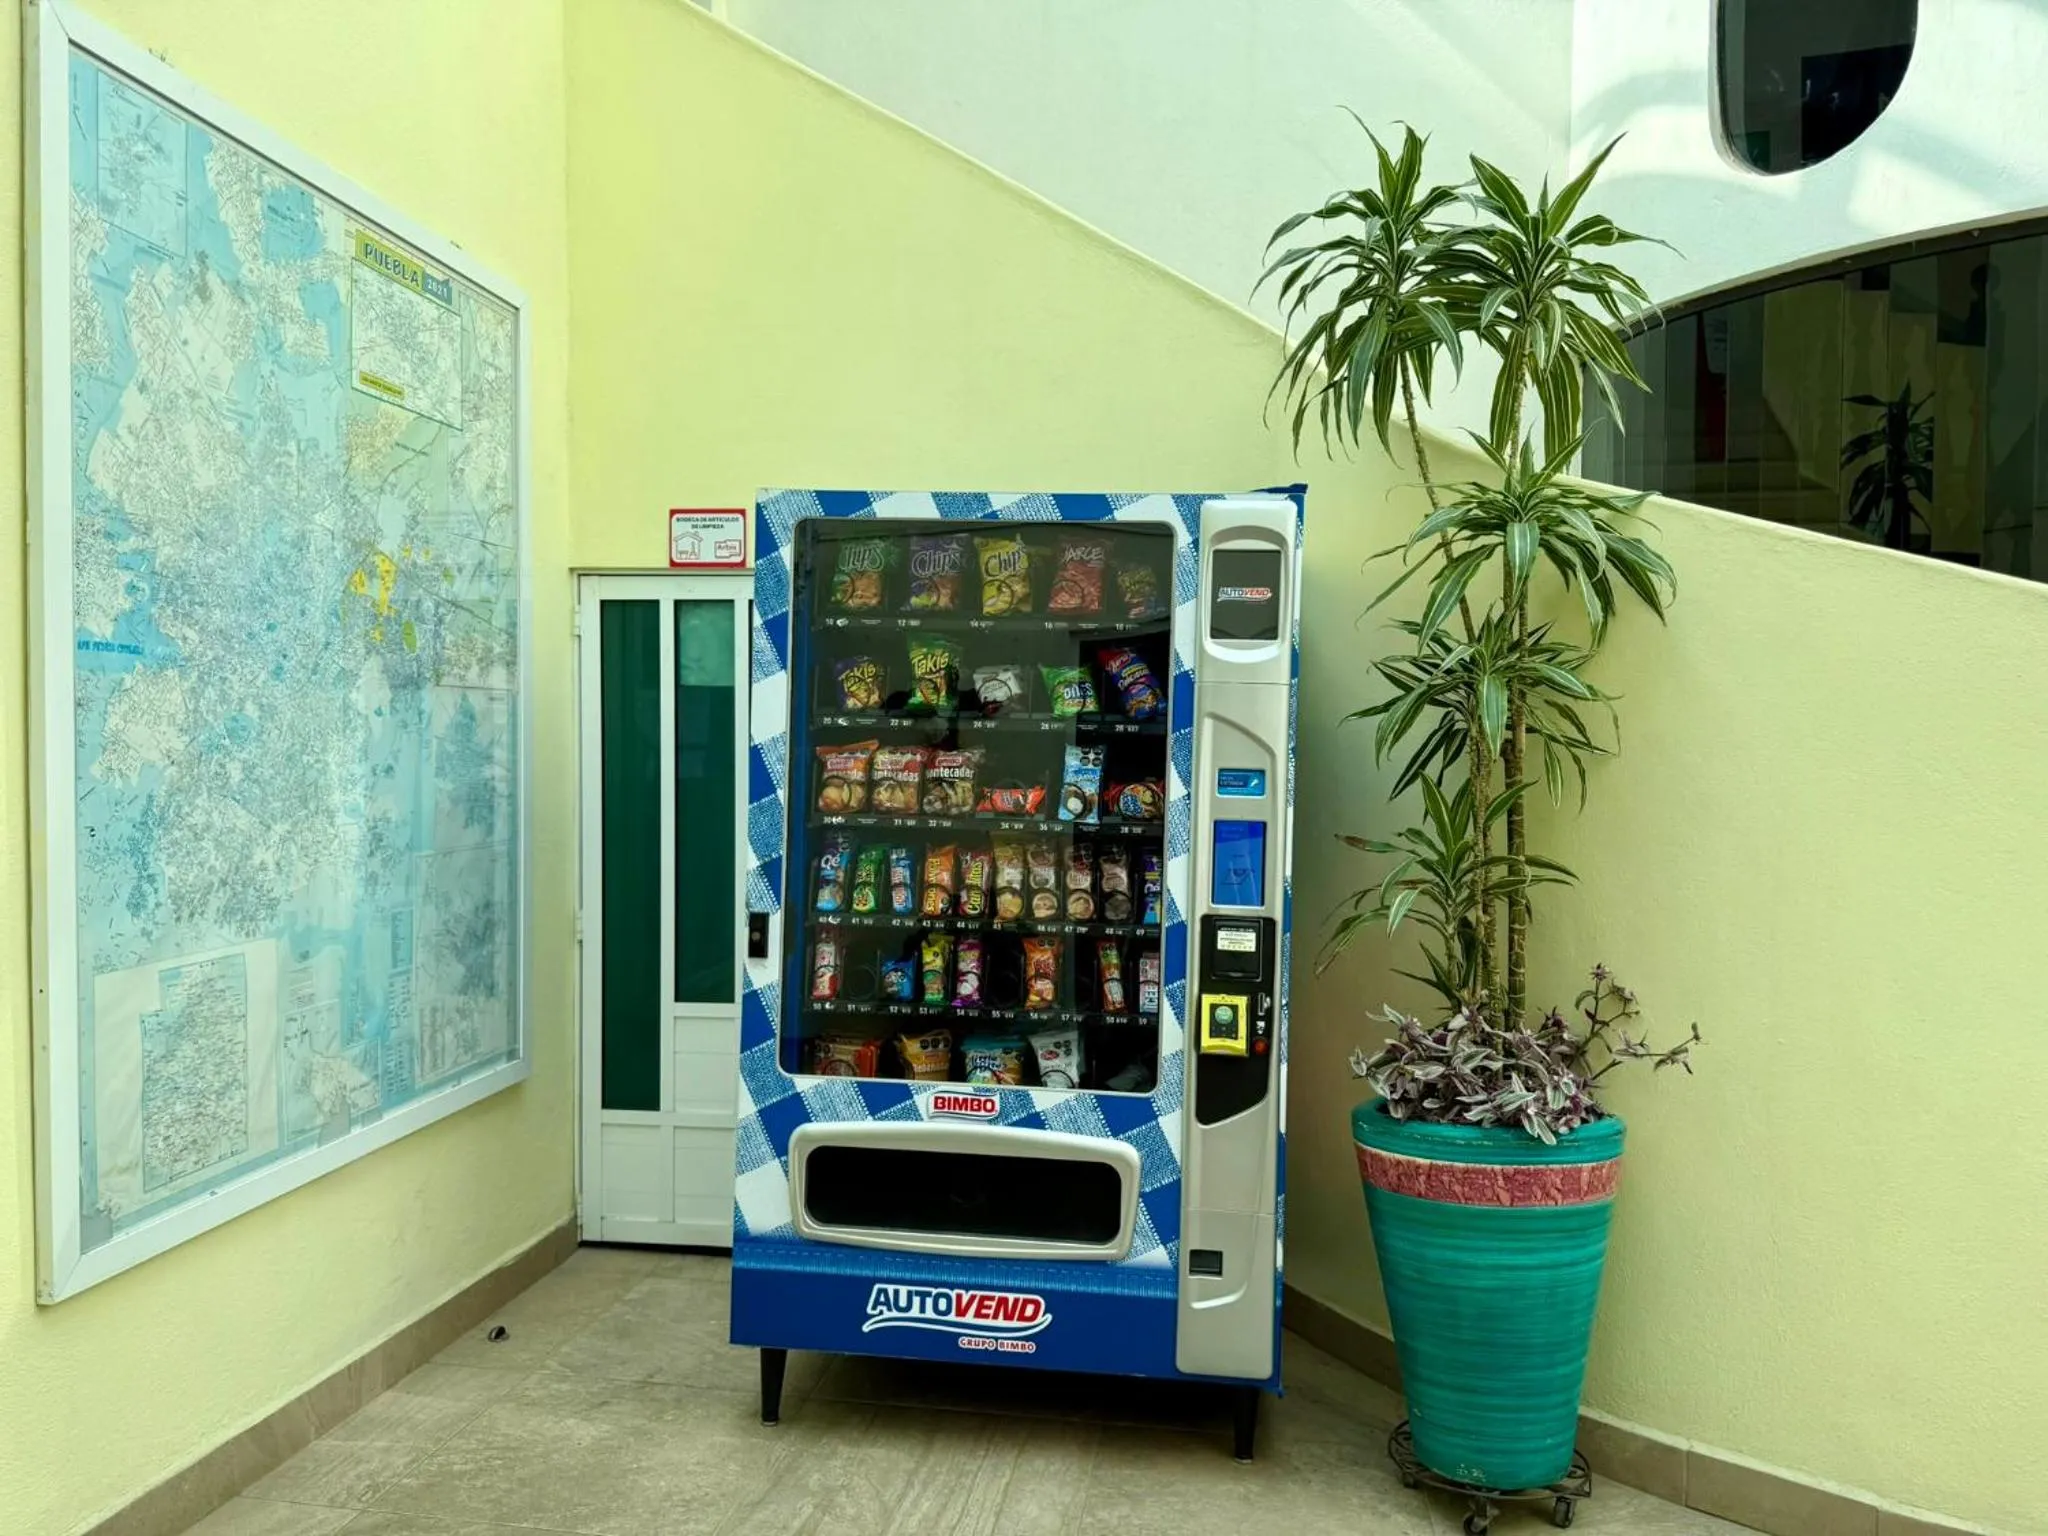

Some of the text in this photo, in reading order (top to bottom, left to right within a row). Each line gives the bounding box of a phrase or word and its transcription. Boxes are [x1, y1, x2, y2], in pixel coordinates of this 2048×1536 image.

[364, 242, 421, 288] PUEBLA
[1219, 586, 1271, 598] AUTOVEND
[912, 652, 949, 677] Takis
[926, 858, 940, 912] Polvoones
[967, 862, 985, 914] Canlitas
[933, 1095, 997, 1113] BIMBO
[869, 1286, 1043, 1323] AUTOVEND
[959, 1337, 1036, 1353] GRUPO BIMBO
